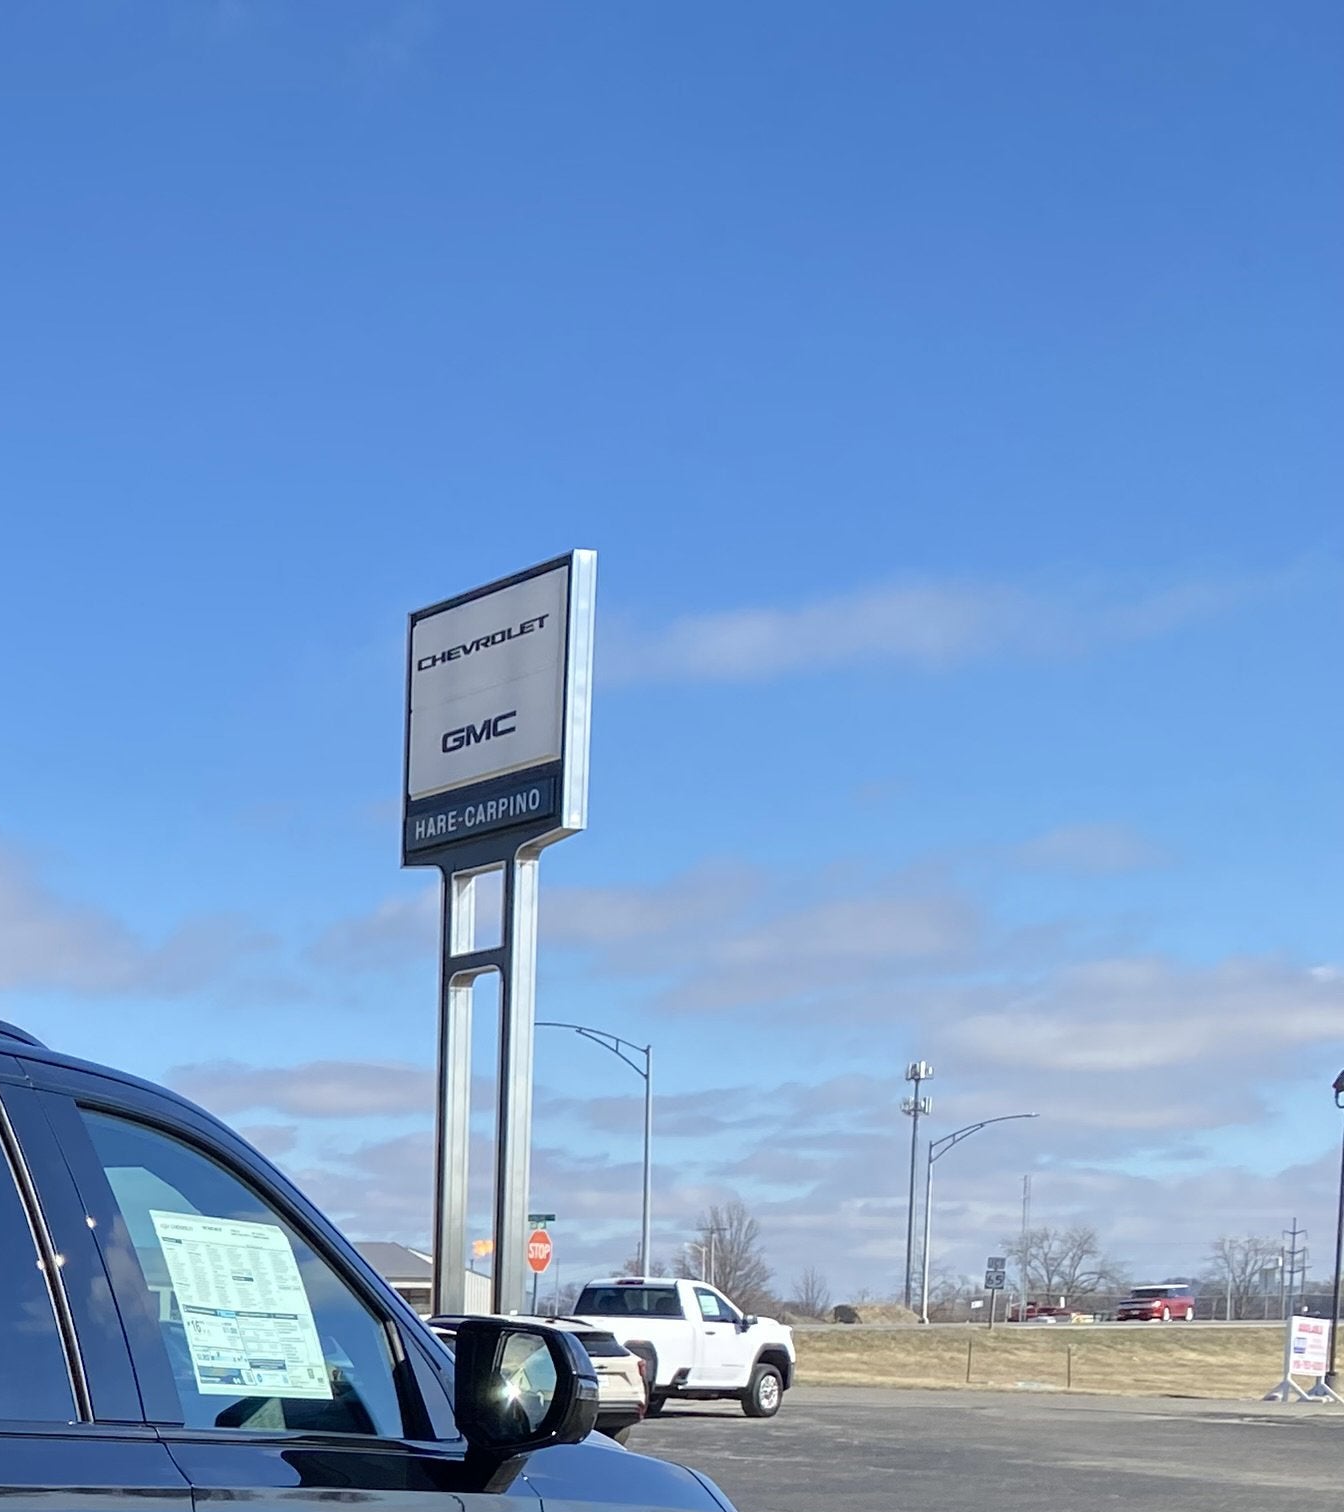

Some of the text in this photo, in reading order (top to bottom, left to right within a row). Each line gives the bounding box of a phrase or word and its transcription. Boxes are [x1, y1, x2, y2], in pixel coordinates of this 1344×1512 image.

[417, 613, 550, 672] CHEVROLET
[441, 710, 518, 754] GMC
[415, 788, 541, 841] HARE-CARPINO
[528, 1242, 551, 1260] STOP
